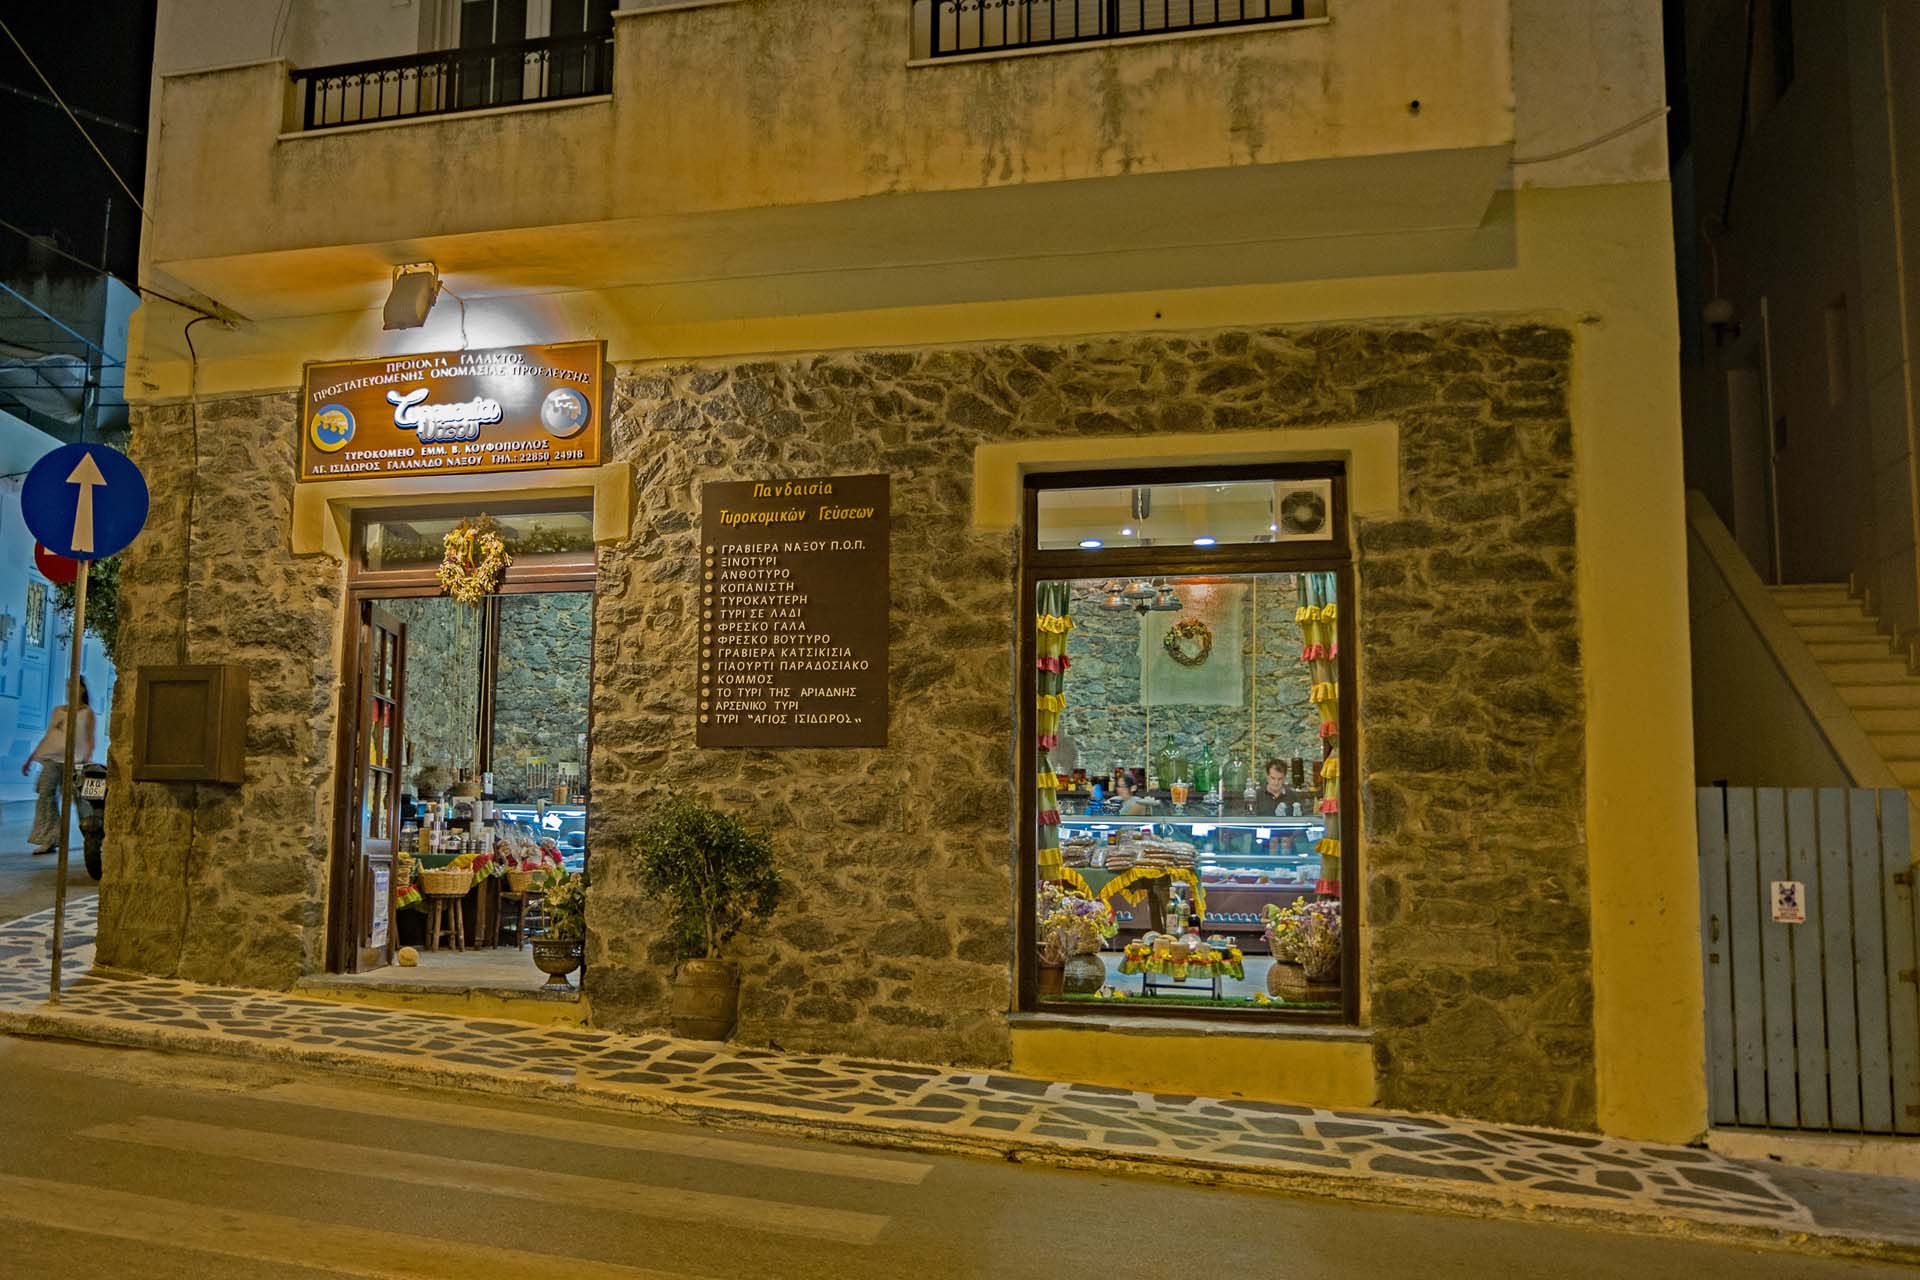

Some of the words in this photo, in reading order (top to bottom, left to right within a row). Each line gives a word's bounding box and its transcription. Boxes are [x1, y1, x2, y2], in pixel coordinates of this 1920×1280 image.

[460, 354, 525, 365] ΓΑΛΑΚΤΟΣ
[313, 371, 425, 402] ΠΡΟΣΤΑΤΕΥΟΜΕΝΗΣ
[430, 365, 506, 378] ΟΝΟΜΑΣΙΑΣ
[512, 366, 590, 384] ΠΡΟΕΛΕΥΣΗΣ
[345, 447, 415, 460] ΤΥΡΟΚΟΜΕΙΟ
[421, 445, 448, 456] ΕΜΜ.
[452, 444, 462, 455] Β.
[464, 440, 549, 454] ΚΟΥΦΟΠΟΥΛΟΣ
[330, 461, 380, 474] ΙΣΙΔΩΡΟΣ
[387, 458, 442, 471] ΓΑΛΑΝΑΔΟ
[446, 455, 482, 468] ΝΑΞΟΥ
[519, 452, 550, 463] 22850
[555, 450, 584, 461] 24918
[753, 481, 832, 498] Πανδαισία
[720, 508, 806, 526] Τυροκομικών
[819, 505, 874, 520] Γεύσεων
[721, 543, 779, 554] ΓΡΑΒΙΕΡΑ
[785, 542, 826, 552] ΝΑΞΟΥ
[831, 540, 866, 550] Π.Ο.Π.
[721, 556, 777, 567] ΞΙΝΟΤΥΡΙ
[721, 569, 790, 580] ΑΝΘΟΤΥΡΟ
[720, 582, 794, 592] ΚΟΠΑΝΙΣΤΗ
[720, 595, 808, 606] ΤΥΡΟΚΑΥΤΕΡΗ
[720, 610, 745, 619] ΤΥΡΙ
[750, 609, 765, 618] ΣΕ
[770, 608, 800, 618] ΛΑΔΙ
[718, 622, 768, 632] ΦΡΕΣΚΟ
[774, 622, 806, 631] ΓΑΛΑ
[718, 635, 768, 645] ΦΡΕΣΚΟ
[774, 634, 830, 644] ΒΟΥΤΥΡΟ
[718, 648, 776, 658] ΓΡΑΒΙΕΡΑ
[781, 648, 852, 657] ΚΑΤΣΙΚΙΣΙΑ
[718, 661, 774, 671] ΓΙΑΟΥΡΤΙ
[780, 661, 869, 670] ΠΑΡΑΔΟΣΙΑΚΟ
[718, 674, 774, 684] ΚΟΜΜΟΣ
[716, 688, 731, 697] ΤΟ
[738, 688, 761, 697] ΤΥΡΙ
[769, 688, 791, 697] ΤΗΣ
[800, 687, 856, 697] ΑΡΙΑΔΝΗΣ
[716, 701, 767, 711] ΑΡΣΕΝΙΚΟ
[775, 701, 799, 710] ΤΥΡΙ
[716, 715, 738, 724] ΤΥΡΙ
